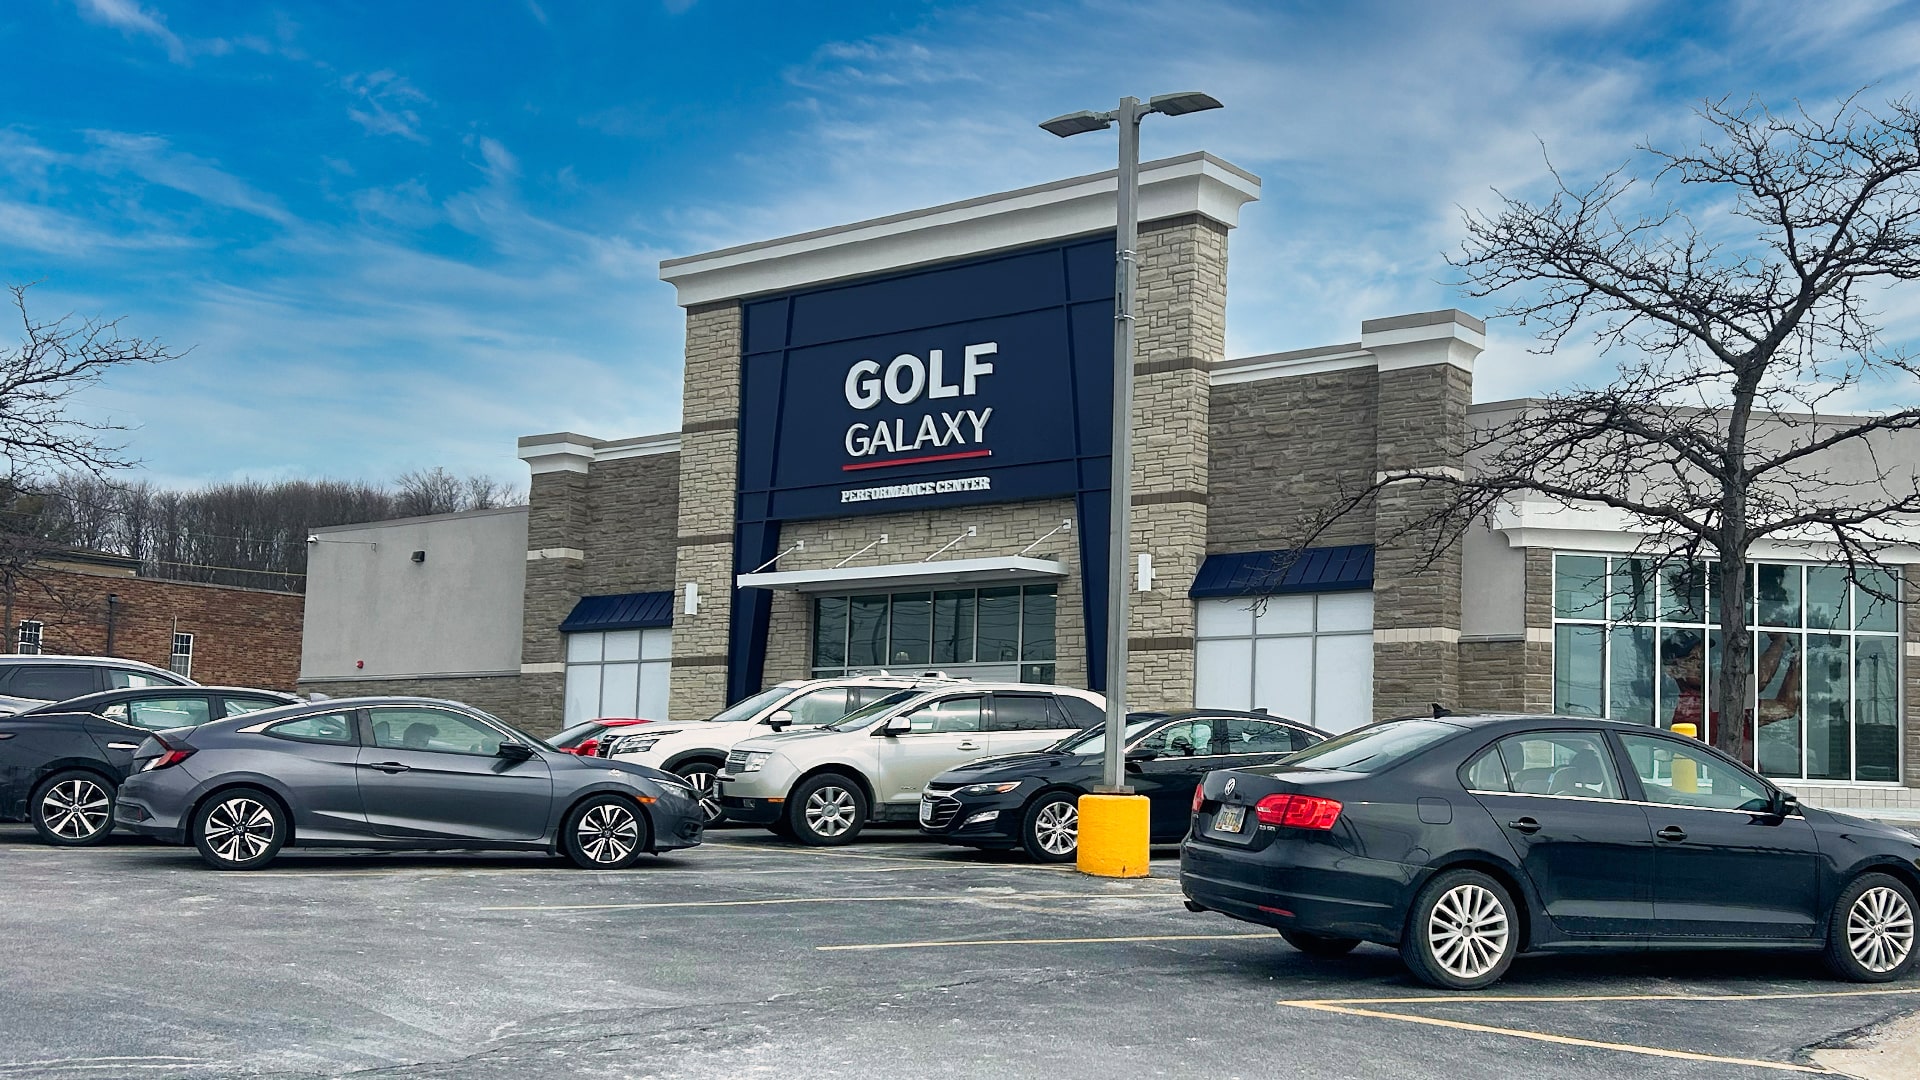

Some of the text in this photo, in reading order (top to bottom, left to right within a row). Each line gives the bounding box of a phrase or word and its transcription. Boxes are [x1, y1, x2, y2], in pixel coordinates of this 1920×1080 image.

[845, 342, 998, 410] GOLF
[845, 407, 993, 457] GALAXY
[841, 476, 991, 502] PERFORMANCE CENTER
